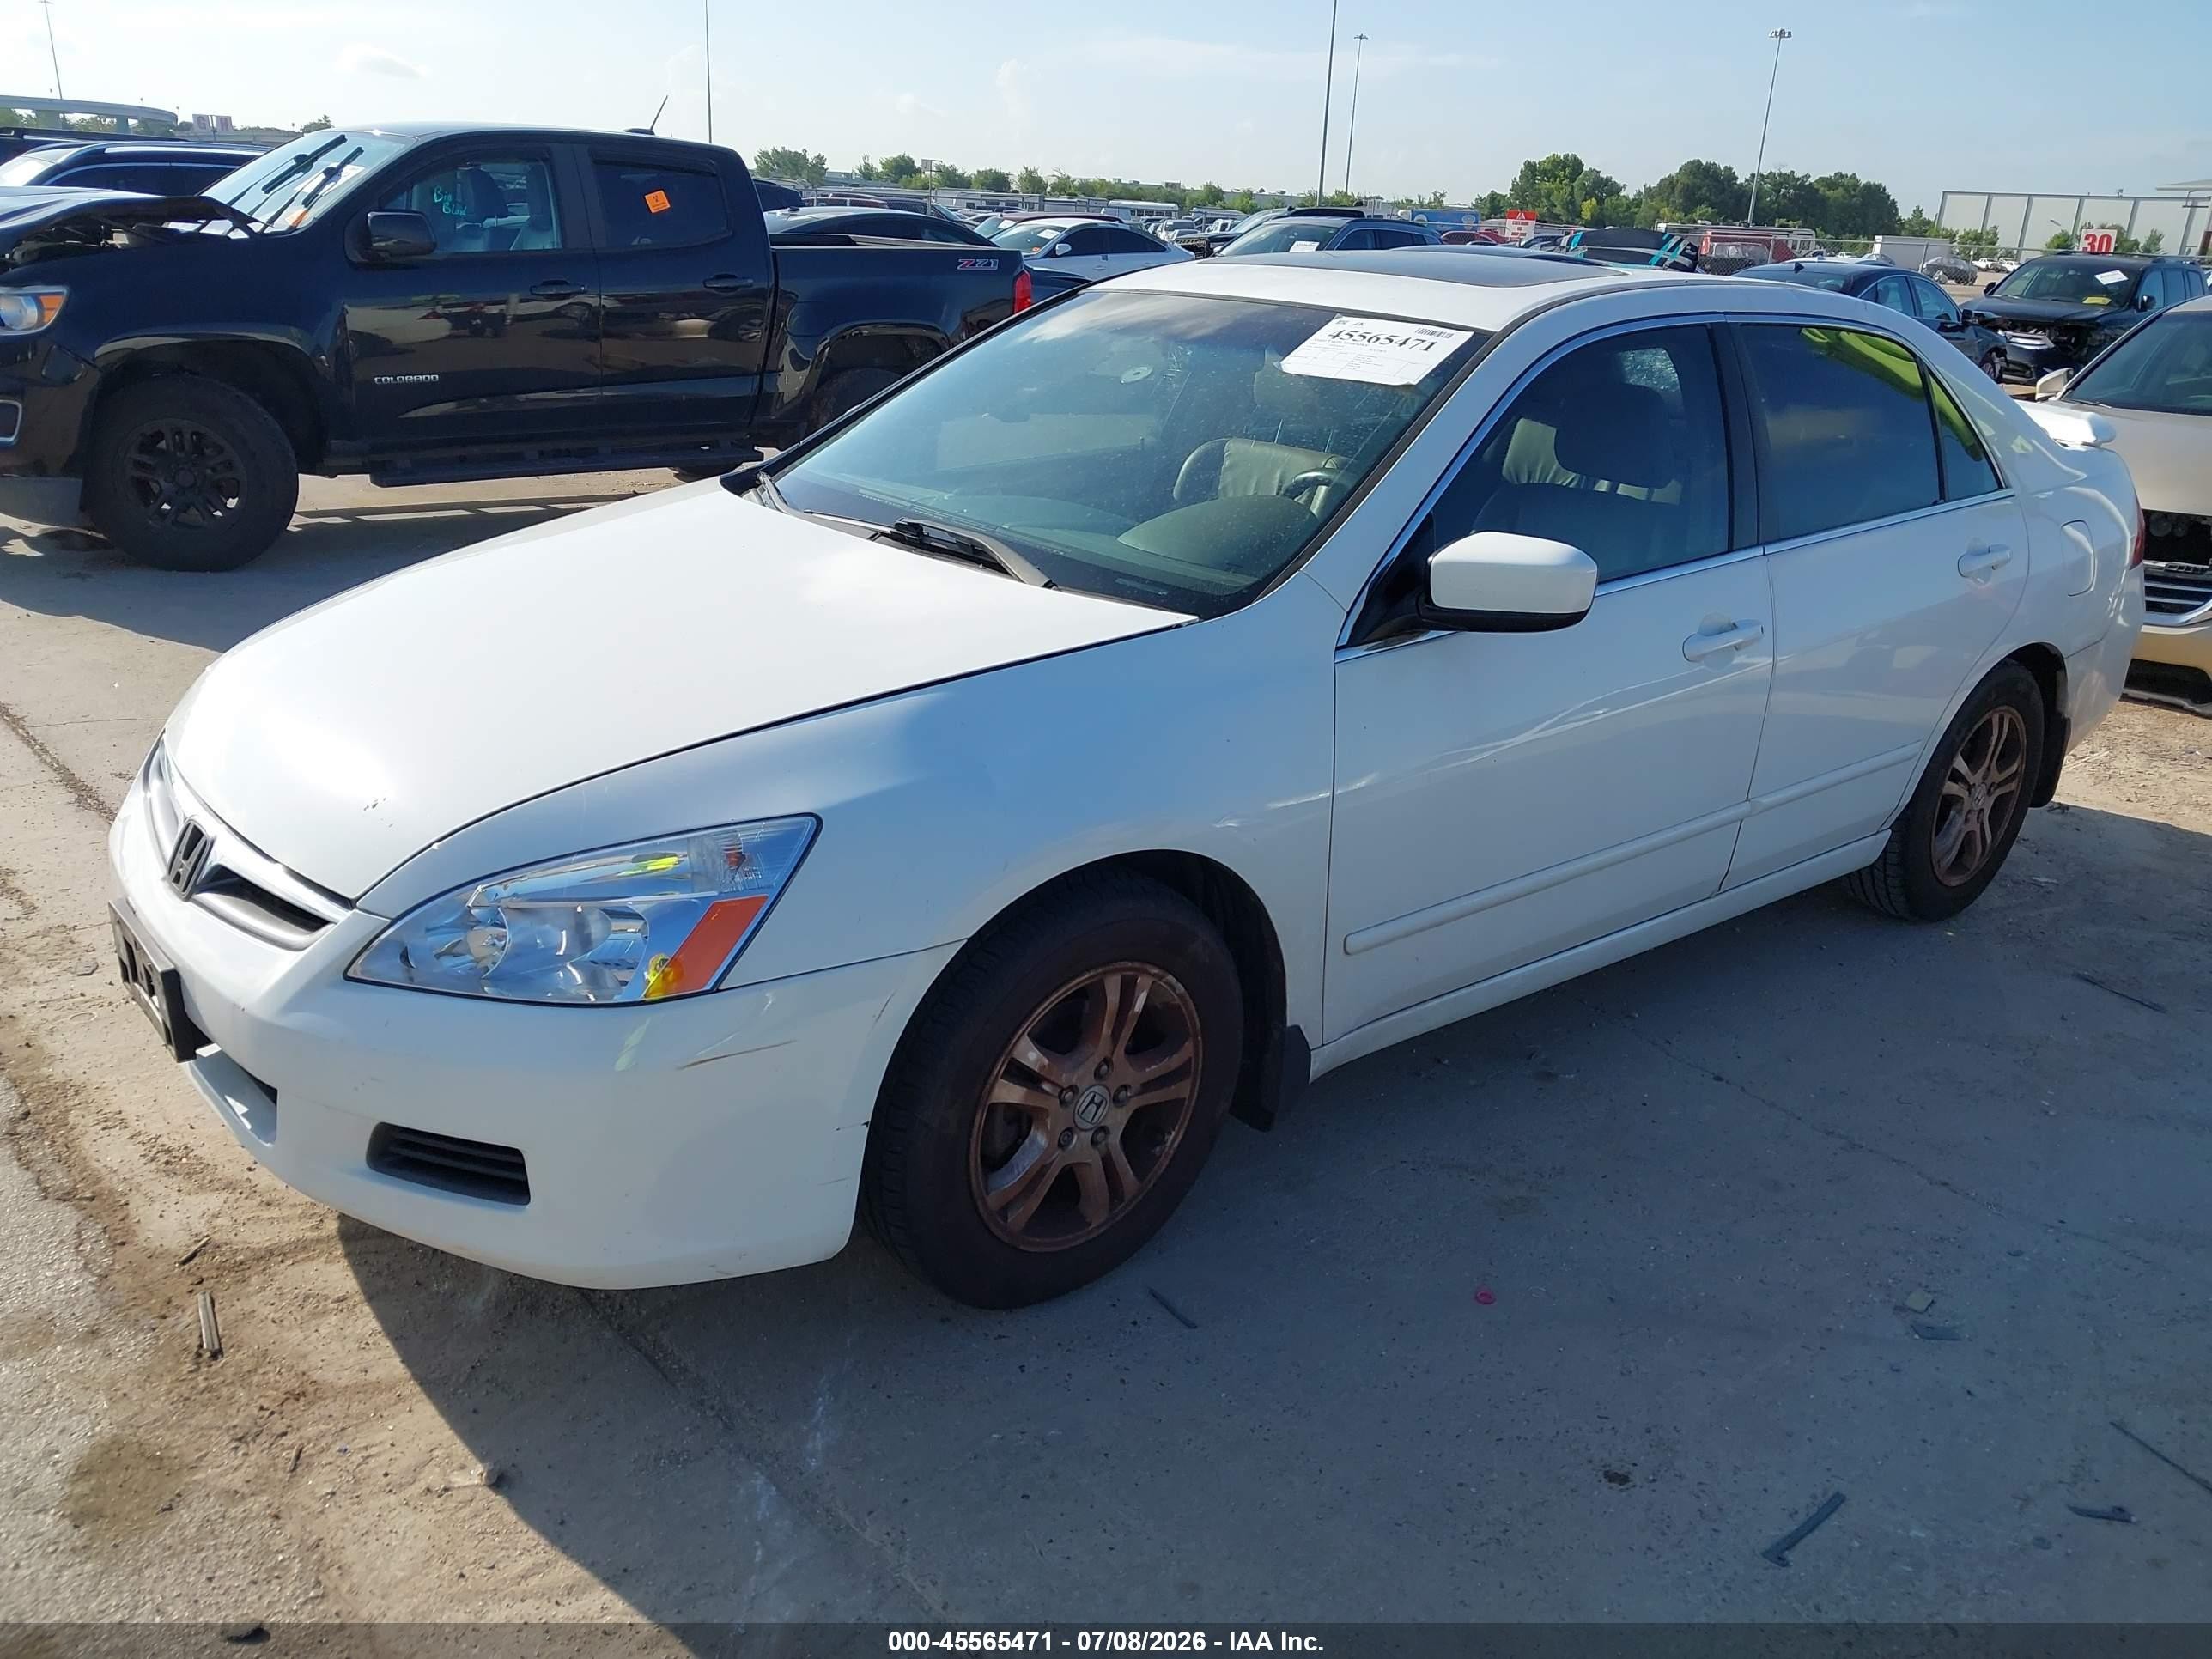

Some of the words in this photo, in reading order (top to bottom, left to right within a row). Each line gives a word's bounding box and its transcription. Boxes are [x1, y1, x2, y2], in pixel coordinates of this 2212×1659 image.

[2082, 234, 2112, 254] 30
[957, 258, 998, 270] Z71
[1328, 329, 1437, 351] 45565471
[374, 374, 439, 384] COLORADO
